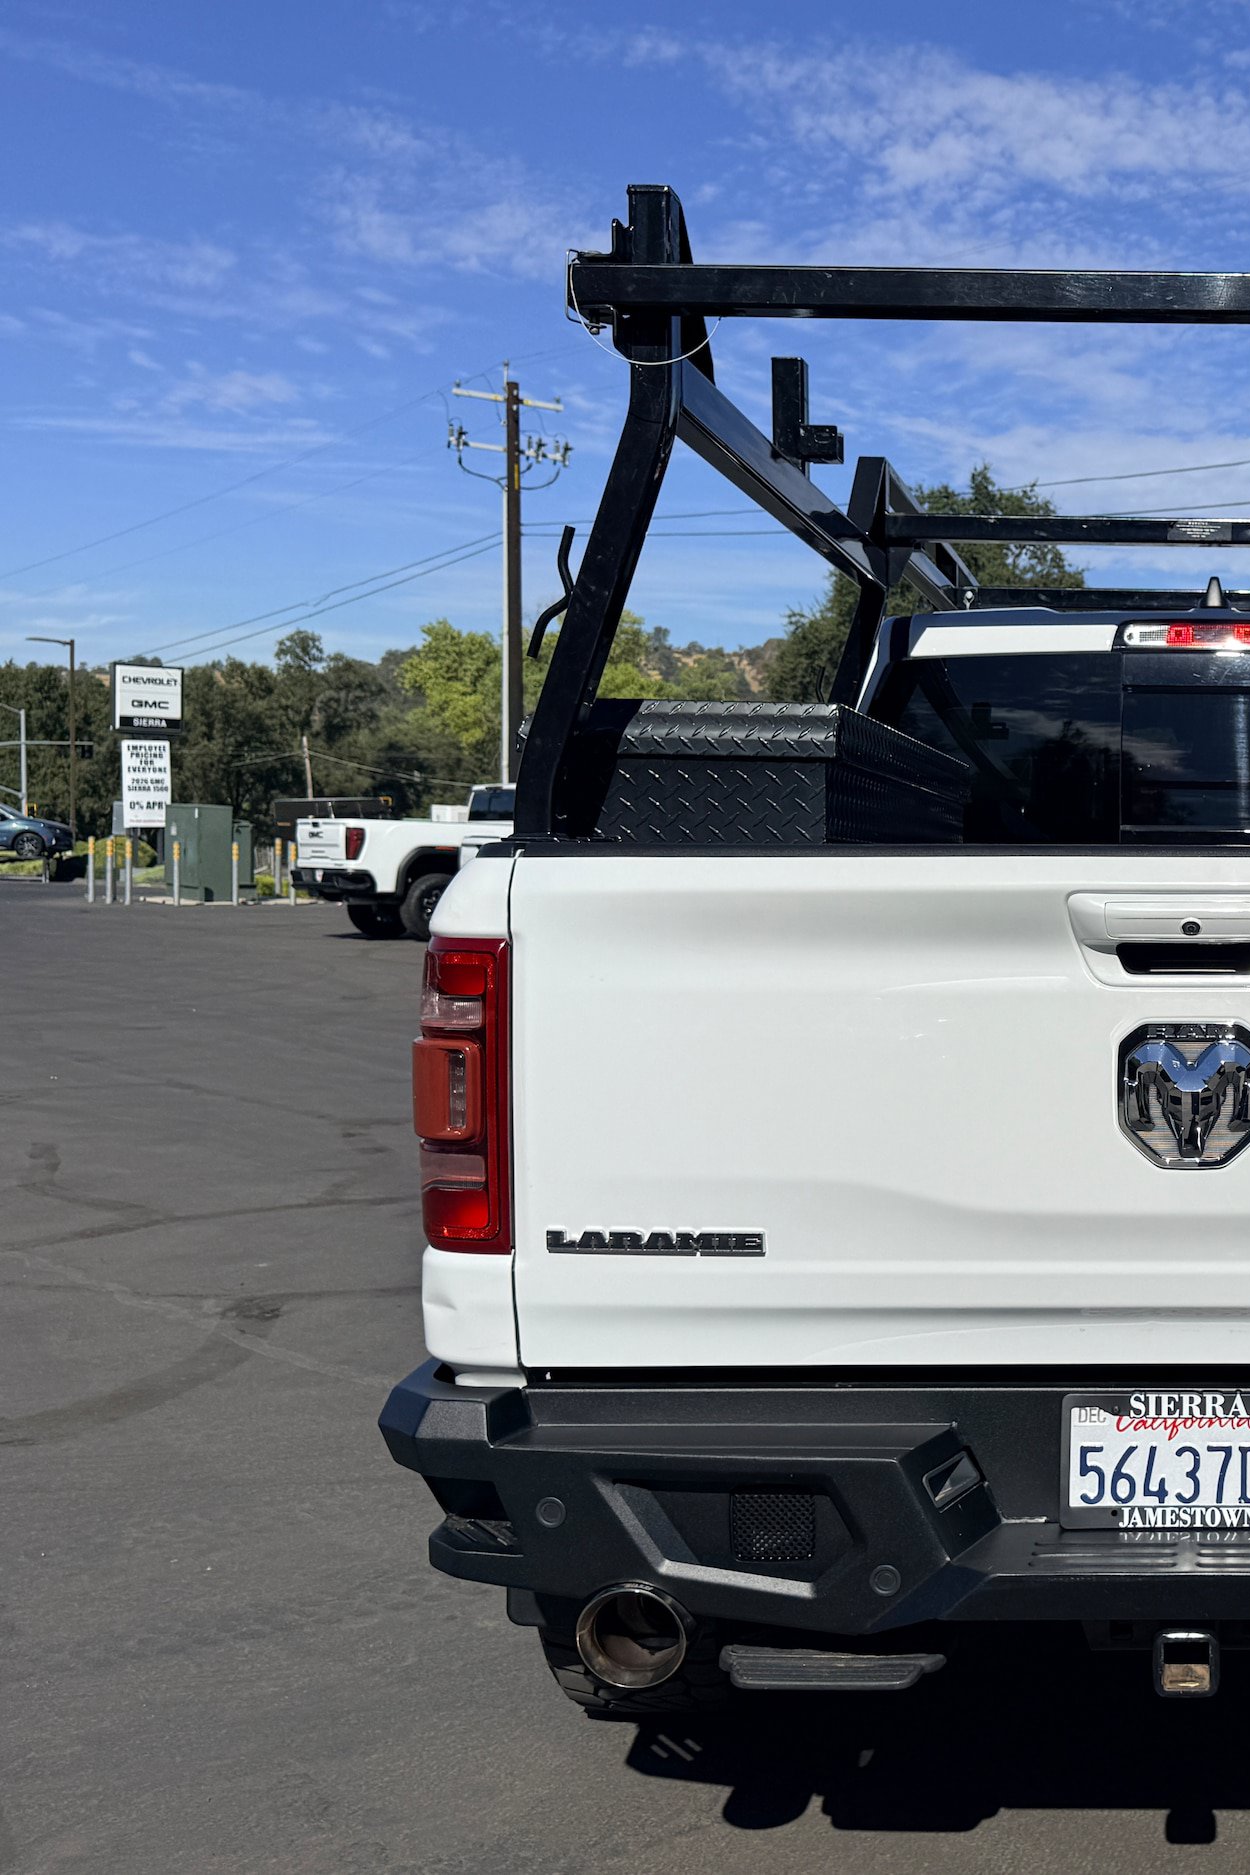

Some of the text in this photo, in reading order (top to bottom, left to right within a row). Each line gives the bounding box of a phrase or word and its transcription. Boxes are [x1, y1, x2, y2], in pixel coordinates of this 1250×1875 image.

[122, 676, 178, 686] CHEVROLET
[131, 700, 169, 709] GMC
[133, 718, 167, 728] SIERRA
[127, 744, 167, 752] EMPLOYEE
[127, 766, 167, 774] EVERYONE
[128, 785, 151, 793] SIERRA
[129, 801, 144, 810] 0%
[1146, 1024, 1235, 1040] RAM
[546, 1228, 766, 1257] LARAMIE
[1129, 1391, 1250, 1419] SIERRA
[1078, 1407, 1107, 1423] DEC
